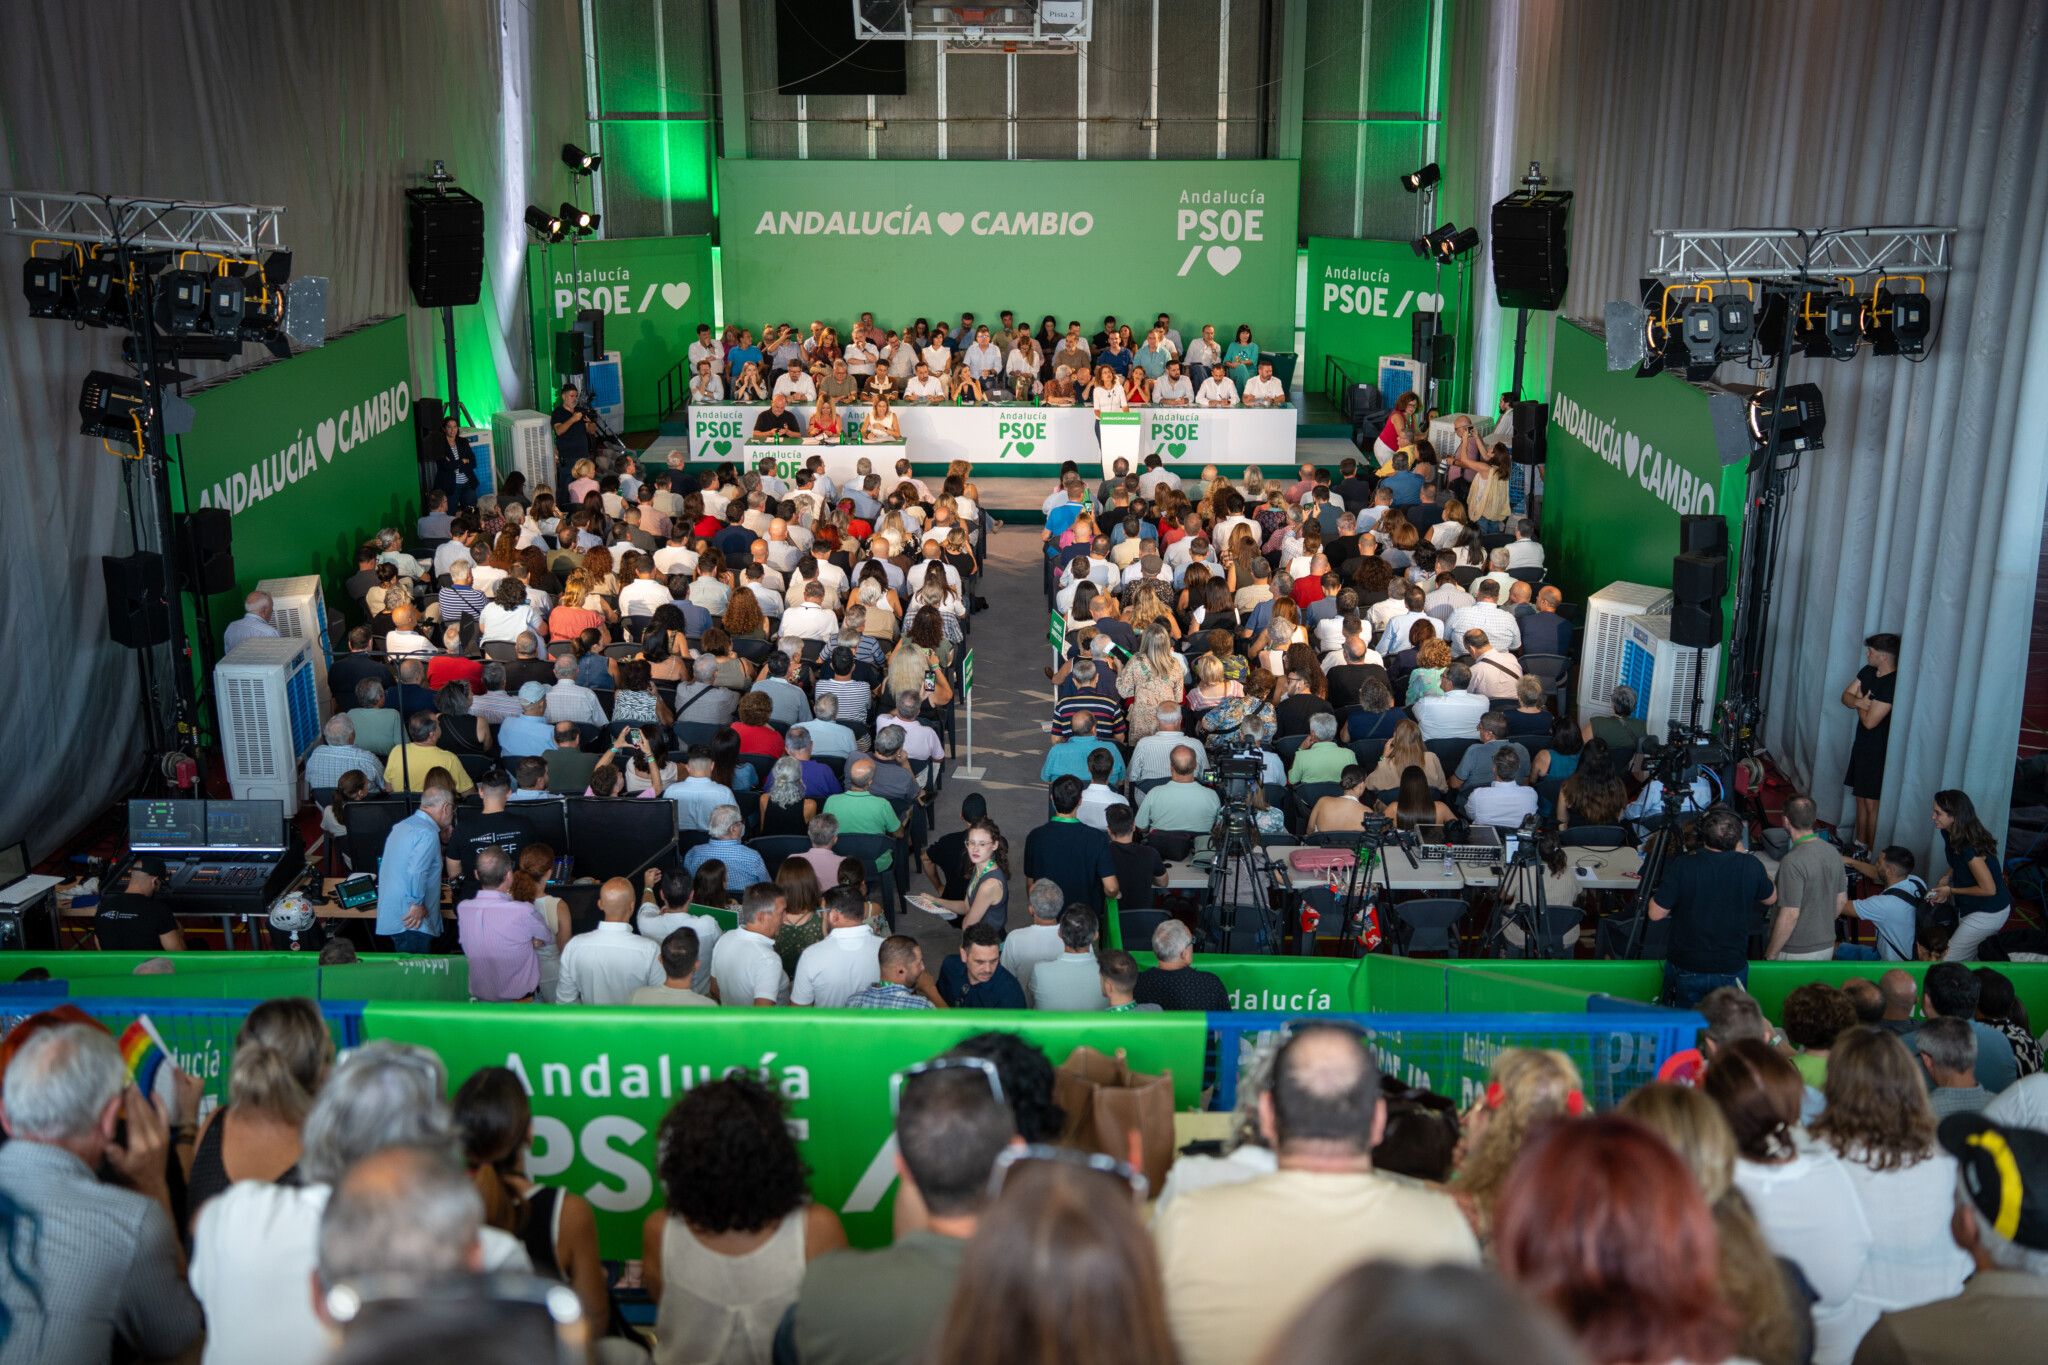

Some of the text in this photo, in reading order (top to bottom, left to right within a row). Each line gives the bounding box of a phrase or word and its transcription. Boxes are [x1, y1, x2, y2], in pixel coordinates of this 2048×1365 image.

[1049, 10, 1068, 18] Pista
[1179, 188, 1265, 204] Andalucía
[754, 203, 1094, 237] ANDALUCÍA CAMBIO
[1177, 209, 1264, 241] PSOE
[1325, 265, 1390, 283] Andalucía
[1323, 282, 1389, 318] PSOE
[696, 410, 743, 419] Andalucía
[1000, 412, 1047, 420] Andalucía
[1152, 412, 1199, 421] Andalucía
[696, 421, 743, 438] PSOE
[999, 422, 1047, 440] PSOE
[1151, 423, 1199, 441] PSOE
[200, 381, 409, 518] ANDALUCÍA CAMBIO
[752, 450, 802, 459] Andalucía
[1552, 391, 1715, 516] ANDALUCÍA CAMBIO
[752, 461, 802, 480] OE
[1228, 988, 1331, 1011] dalucía
